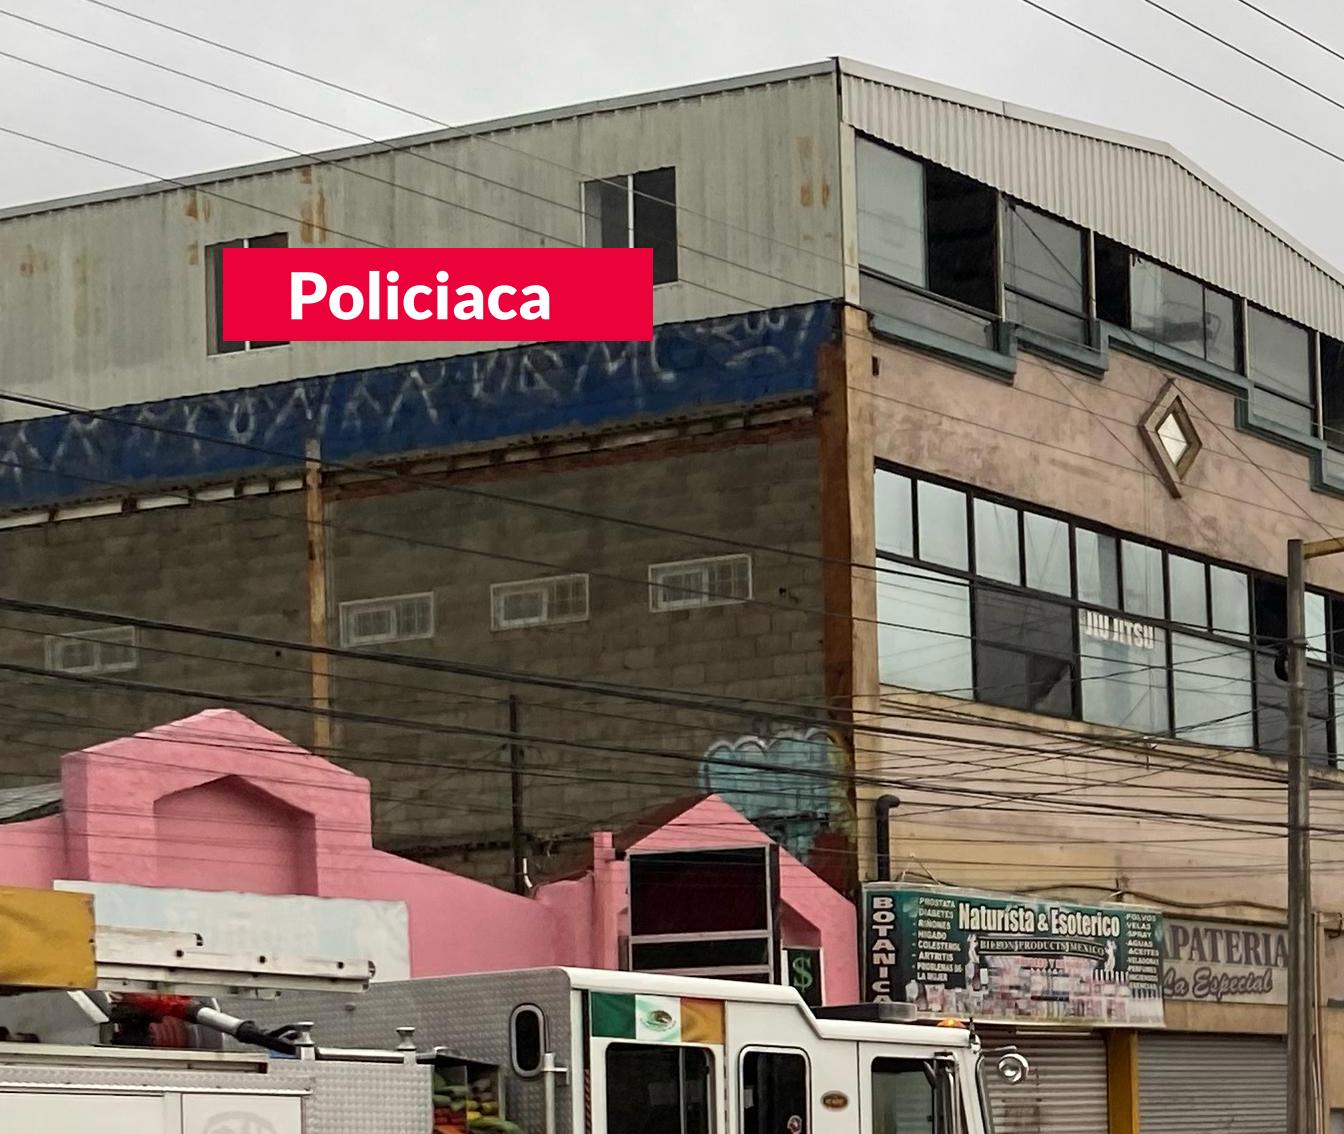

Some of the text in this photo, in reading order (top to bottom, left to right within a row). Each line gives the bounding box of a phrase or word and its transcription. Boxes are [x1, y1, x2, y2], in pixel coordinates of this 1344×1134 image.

[1037, 914, 1049, 932] &
[1051, 908, 1121, 938] Esoterico
[1192, 966, 1273, 1001] Especial
